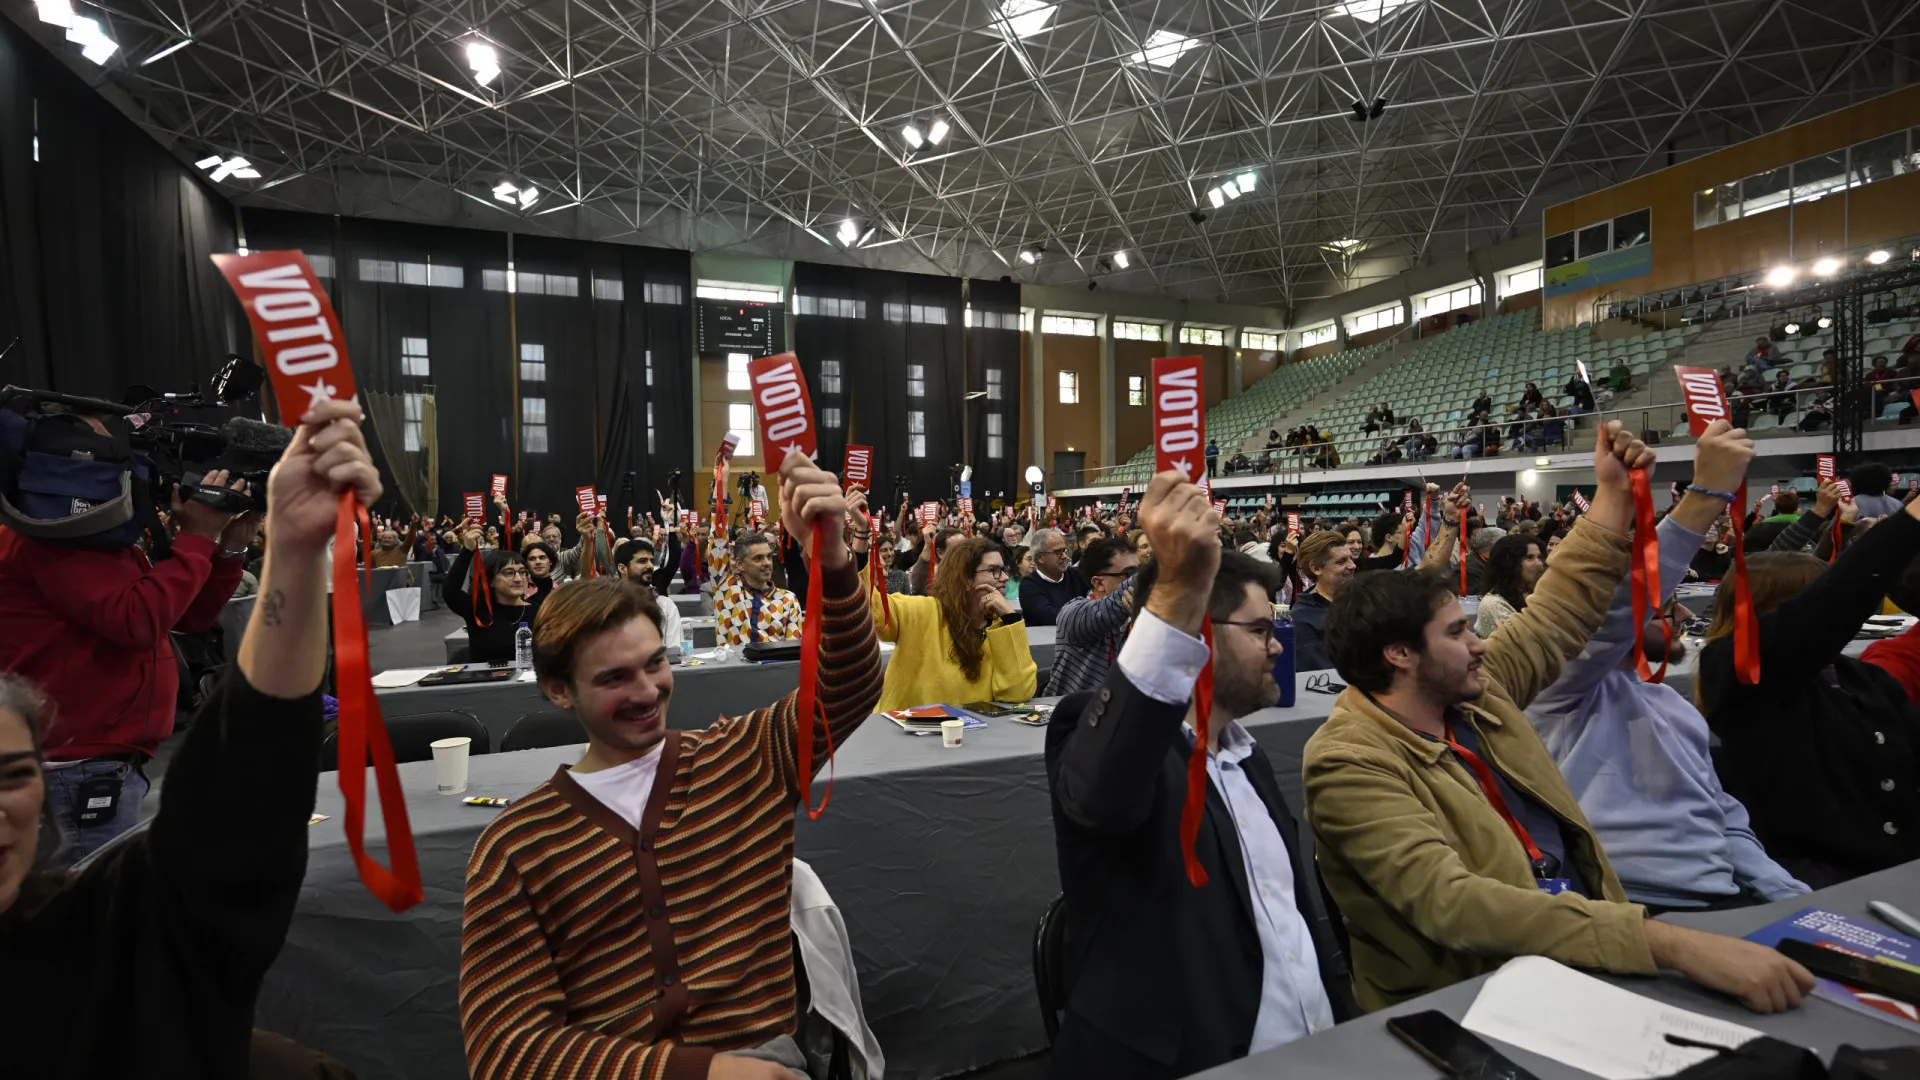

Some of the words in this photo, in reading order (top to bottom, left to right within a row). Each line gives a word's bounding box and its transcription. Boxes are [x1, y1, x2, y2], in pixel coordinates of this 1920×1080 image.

[238, 263, 339, 376] VOTO
[756, 362, 808, 441] VOTO
[1682, 373, 1725, 417] VOTO
[1158, 367, 1199, 453] VOTO
[847, 450, 869, 480] VOTO
[1819, 457, 1834, 477] VOTO
[493, 476, 506, 492] VOTO
[466, 495, 483, 517] VOTO
[578, 488, 597, 511] VOTO
[1574, 490, 1590, 512] VOTO
[924, 503, 936, 520] VOTO
